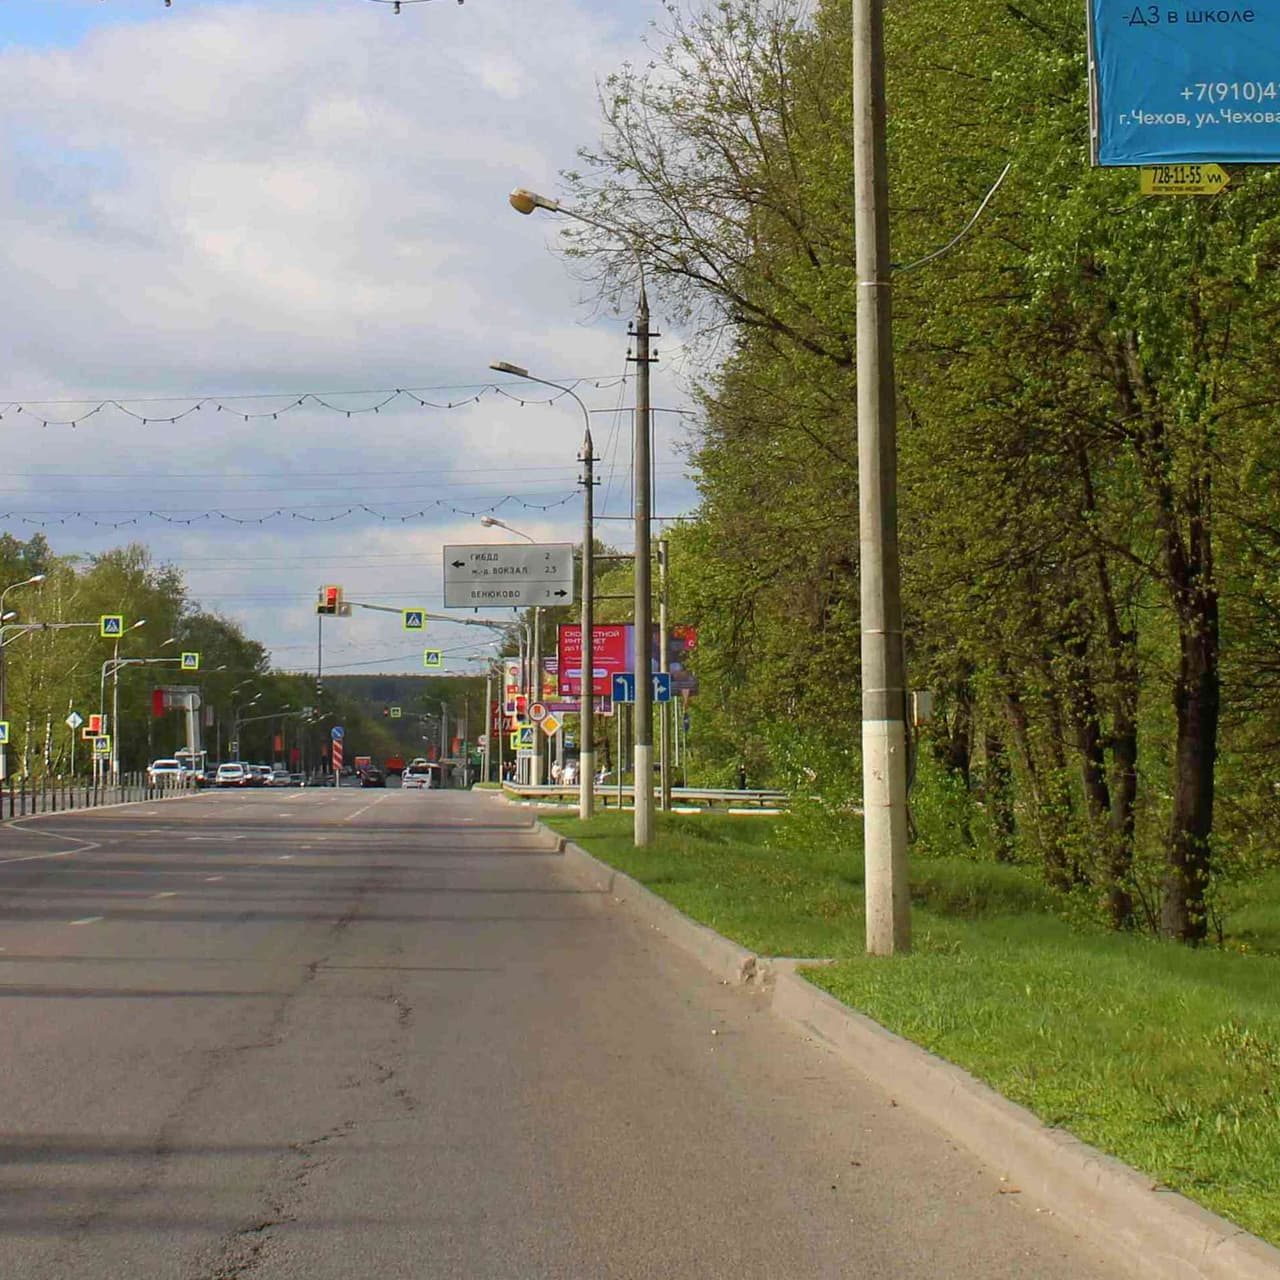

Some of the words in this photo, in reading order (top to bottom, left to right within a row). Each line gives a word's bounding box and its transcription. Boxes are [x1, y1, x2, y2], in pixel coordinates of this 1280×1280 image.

[1167, 11, 1179, 24] в
[1185, 8, 1255, 24] школе
[1119, 109, 1191, 127] г.Чехов,
[1152, 166, 1202, 184] 728-11-55
[470, 553, 499, 561] ГИБДД
[492, 567, 528, 575] ВОКЗАЛ
[471, 590, 521, 598] ВЕНЮКОВО
[564, 630, 620, 638] СКОСТНОЙ
